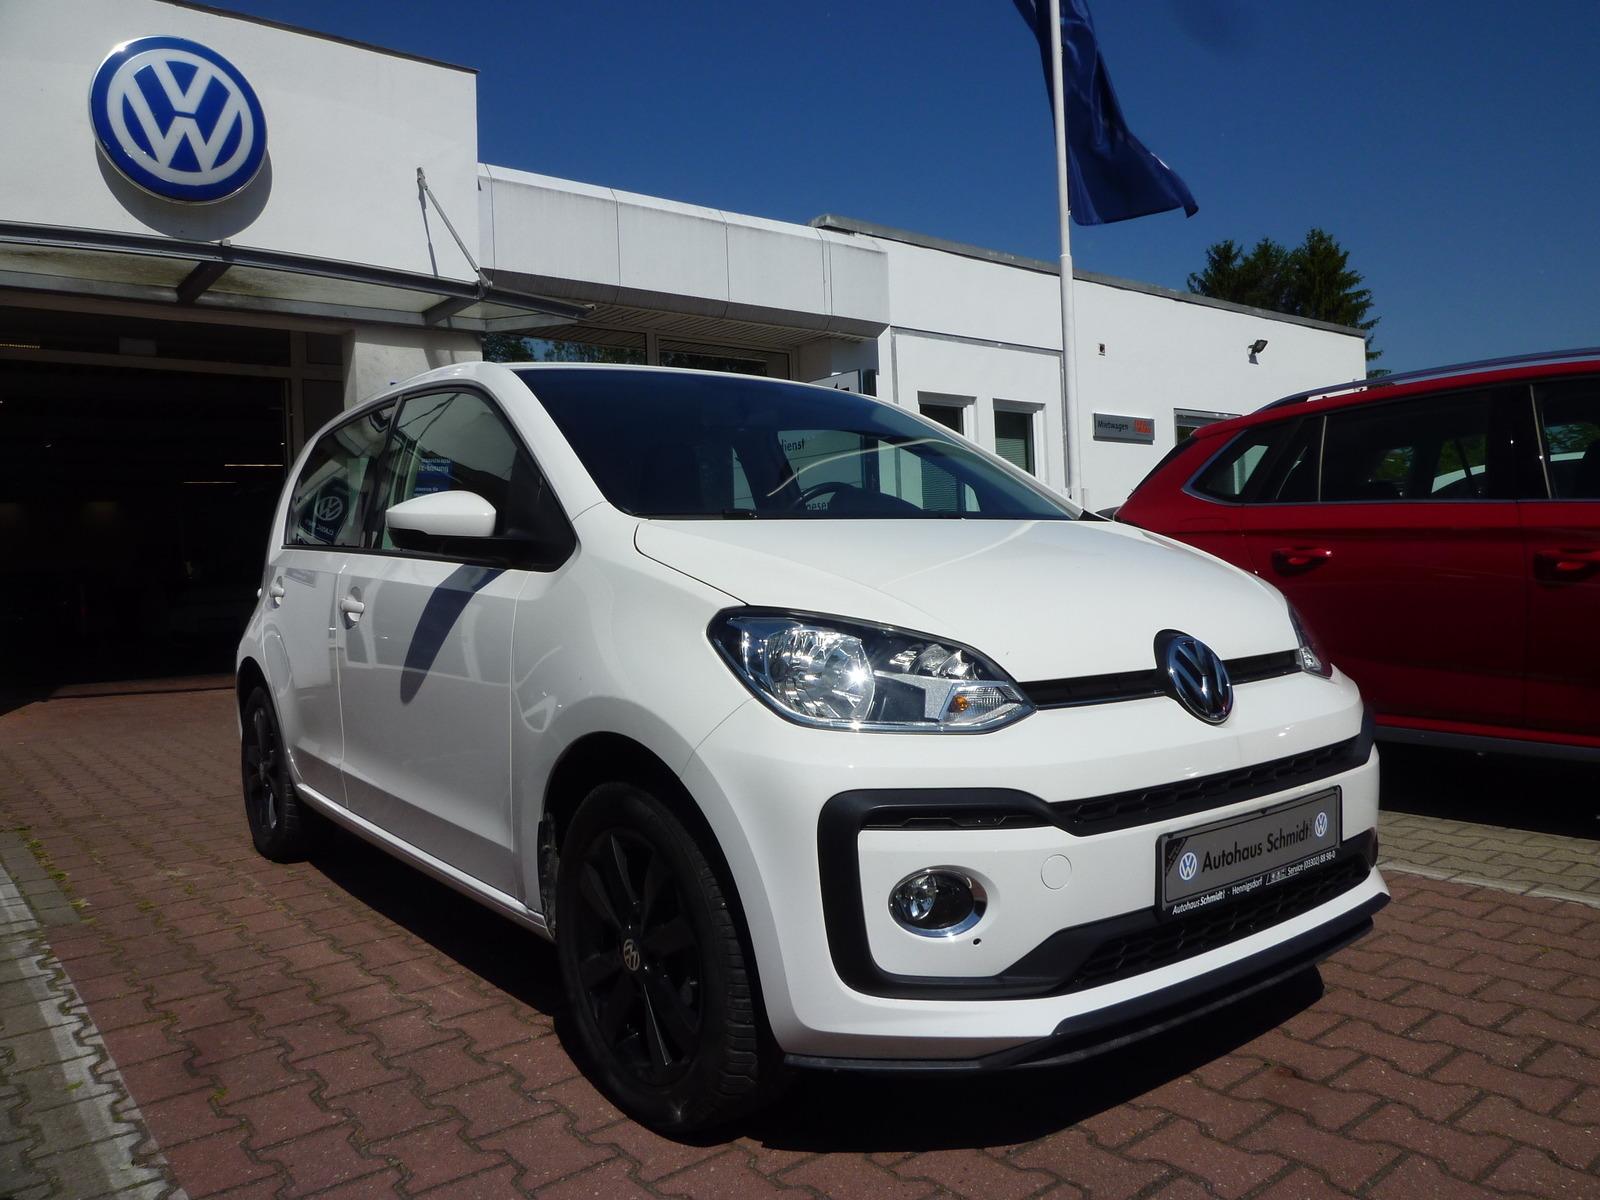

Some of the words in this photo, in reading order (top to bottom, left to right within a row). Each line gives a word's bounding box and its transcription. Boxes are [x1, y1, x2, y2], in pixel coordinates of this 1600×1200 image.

[106, 48, 255, 186] VW
[1201, 841, 1263, 873] Autohaus
[1266, 821, 1310, 853] Schmidt
[1172, 900, 1200, 915] Autohaus
[1231, 876, 1263, 895] Hennigsdorf
